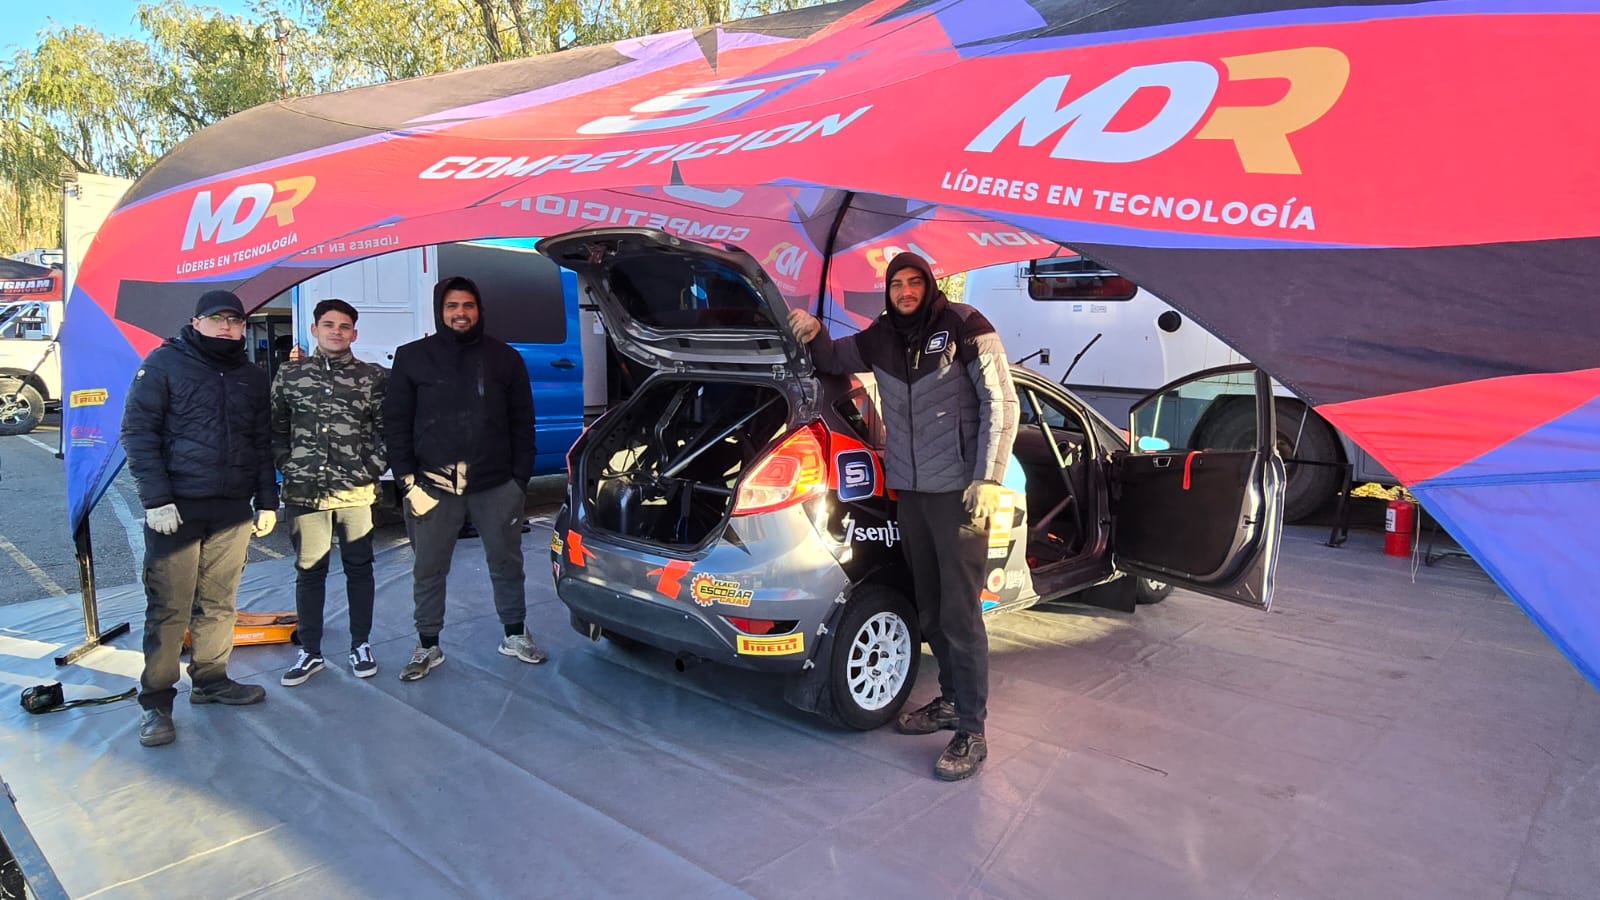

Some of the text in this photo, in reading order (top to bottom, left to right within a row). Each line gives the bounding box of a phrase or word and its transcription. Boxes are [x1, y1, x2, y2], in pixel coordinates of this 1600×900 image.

[964, 46, 1351, 175] MDR
[418, 105, 873, 180] COMPETICION
[181, 175, 317, 252] MDR
[941, 167, 1317, 231] LÍDERES EN TECNOLOGÍA
[176, 230, 299, 275] LÍDERES EN TECNOLOGÍA
[700, 585, 753, 599] ESCOBAR
[714, 580, 739, 589] FLACO
[742, 638, 798, 652] PIRELLI
